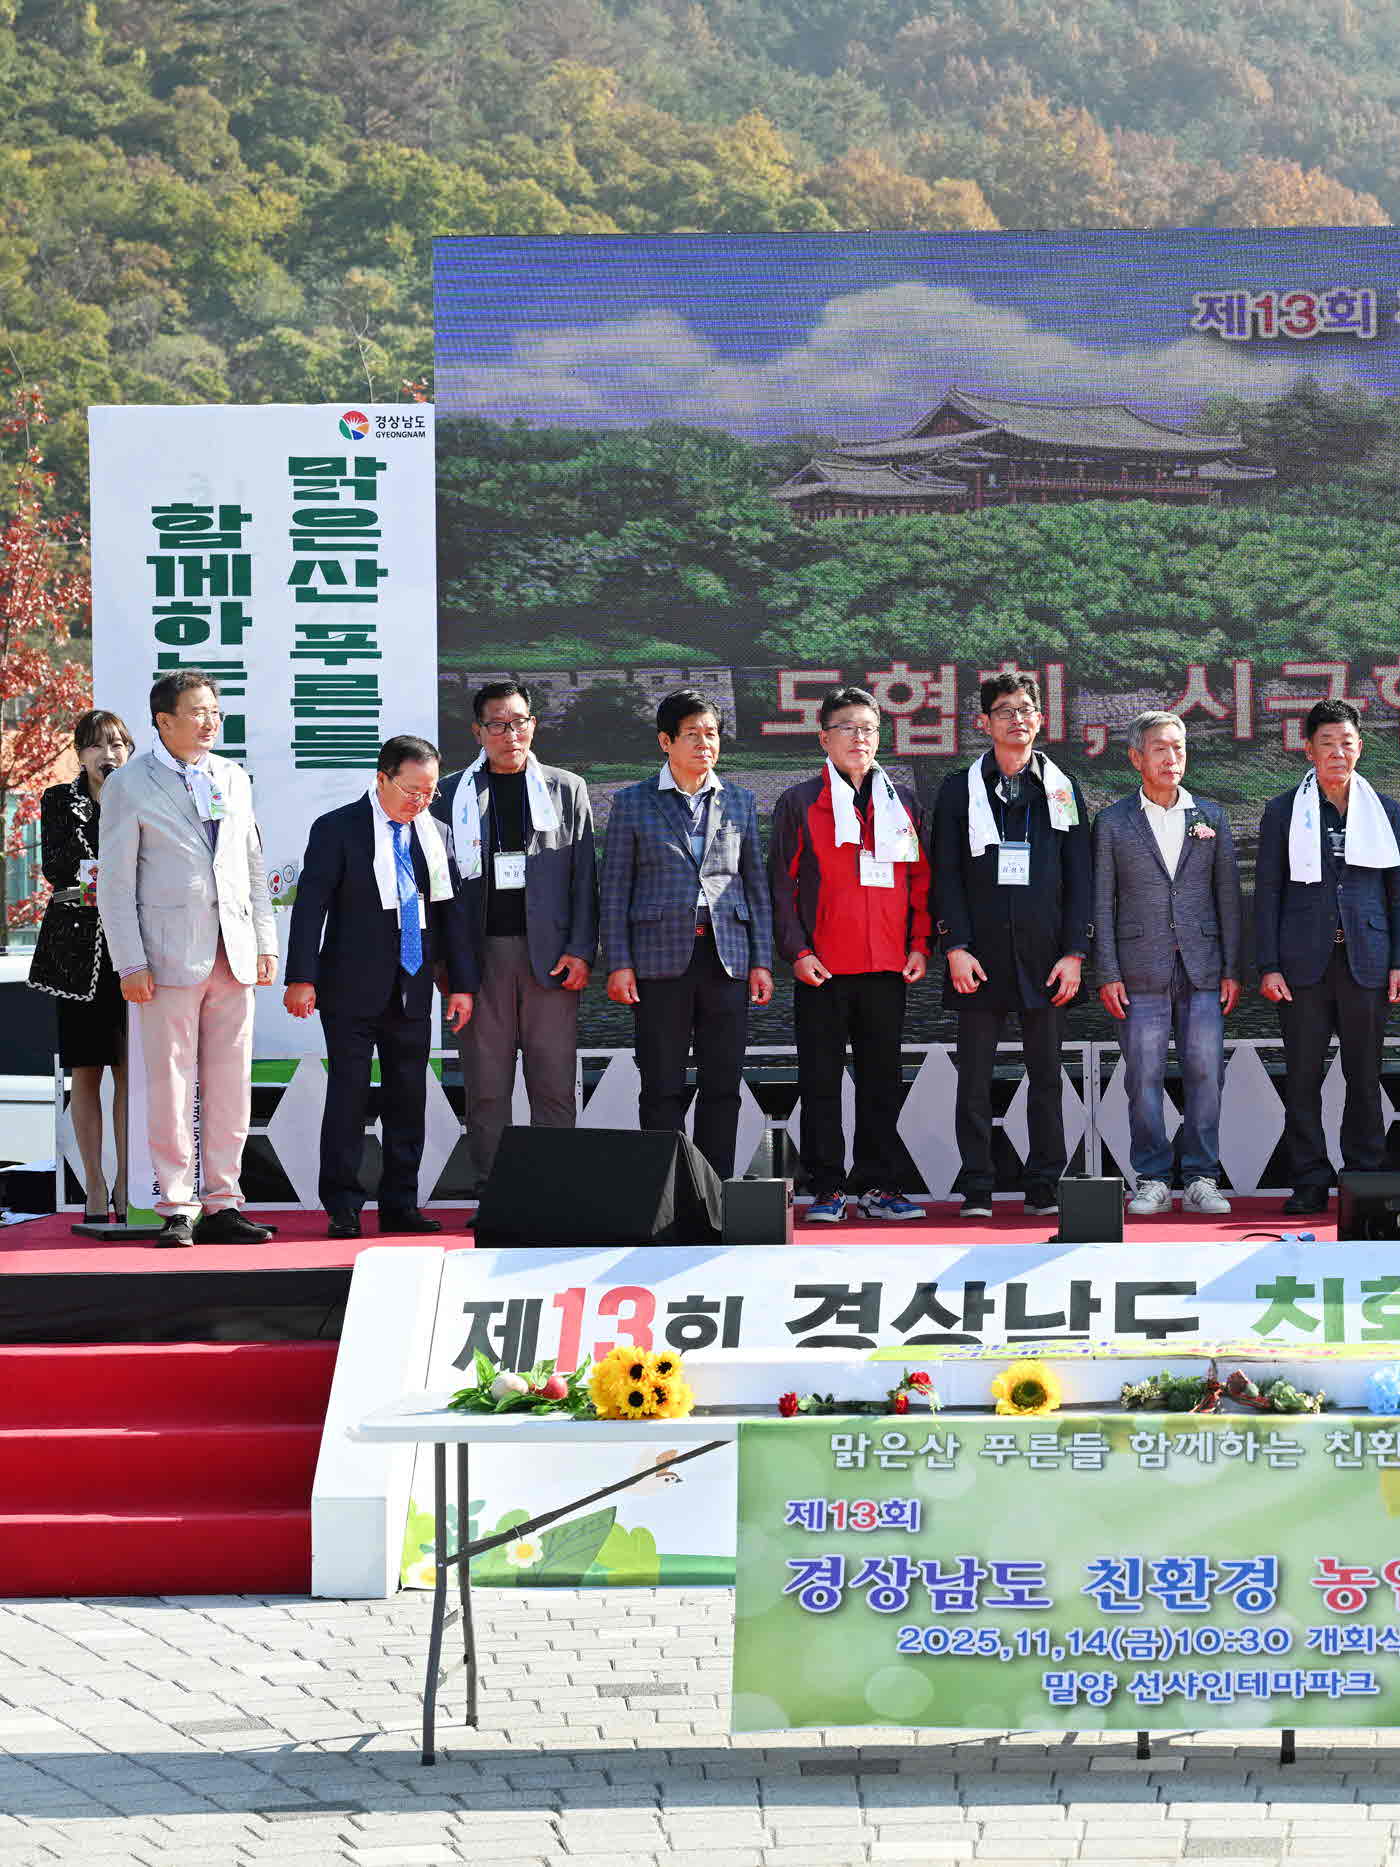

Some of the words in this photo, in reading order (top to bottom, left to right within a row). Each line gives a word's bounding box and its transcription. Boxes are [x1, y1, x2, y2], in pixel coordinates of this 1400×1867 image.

[1191, 288, 1377, 339] 제13회
[375, 415, 426, 429] 경상남도
[288, 456, 388, 603] 맑은산
[289, 623, 382, 769] 푸른들
[830, 1432, 960, 1470] 맑은산
[979, 1431, 1110, 1470] 푸른들
[1129, 1431, 1304, 1469] 함께하는
[784, 1498, 922, 1533] 제13회
[782, 1554, 1053, 1614] 경상남도
[1081, 1555, 1279, 1613] 친환경
[1042, 1671, 1116, 1706] 밀양
[1128, 1670, 1381, 1704] 선샤인테마파크
